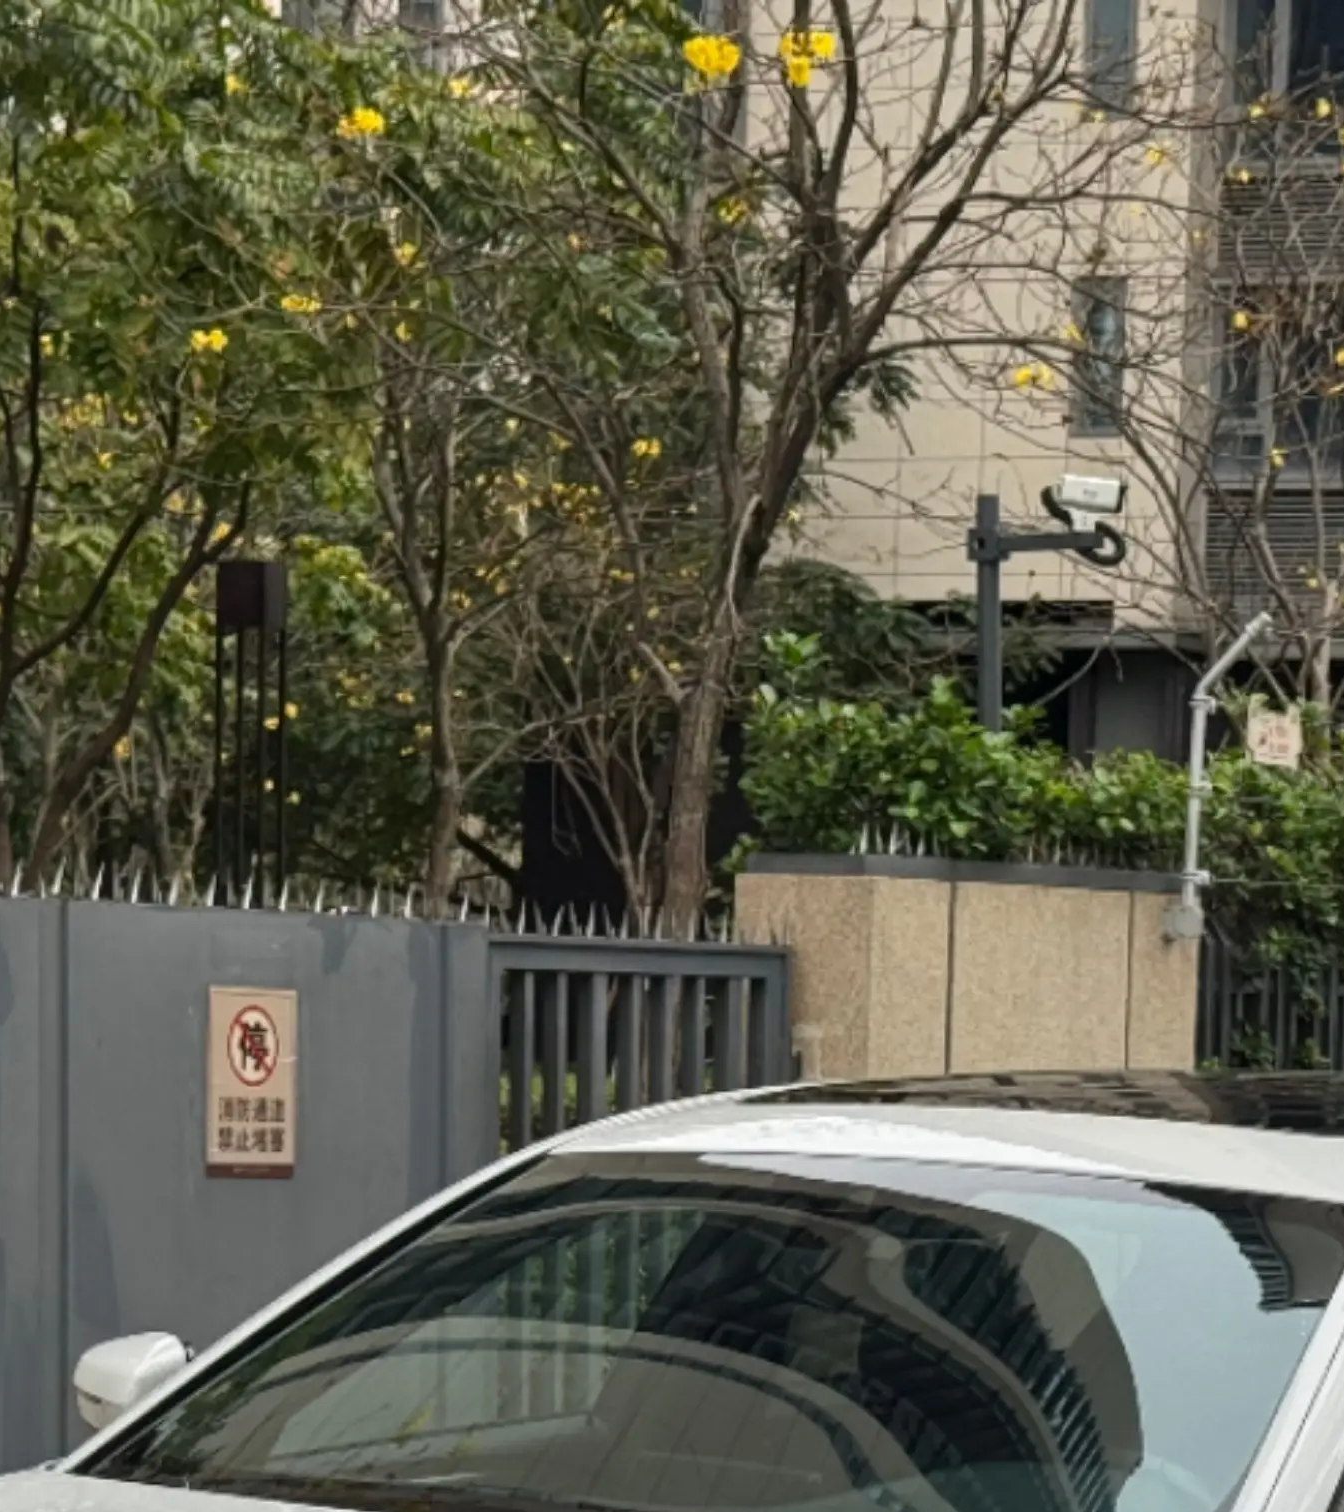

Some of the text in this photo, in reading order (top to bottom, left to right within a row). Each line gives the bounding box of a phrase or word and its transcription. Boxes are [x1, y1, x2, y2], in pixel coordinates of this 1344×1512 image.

[218, 1096, 285, 1122] 消防通道
[218, 1126, 285, 1152] 禁止堵塞
